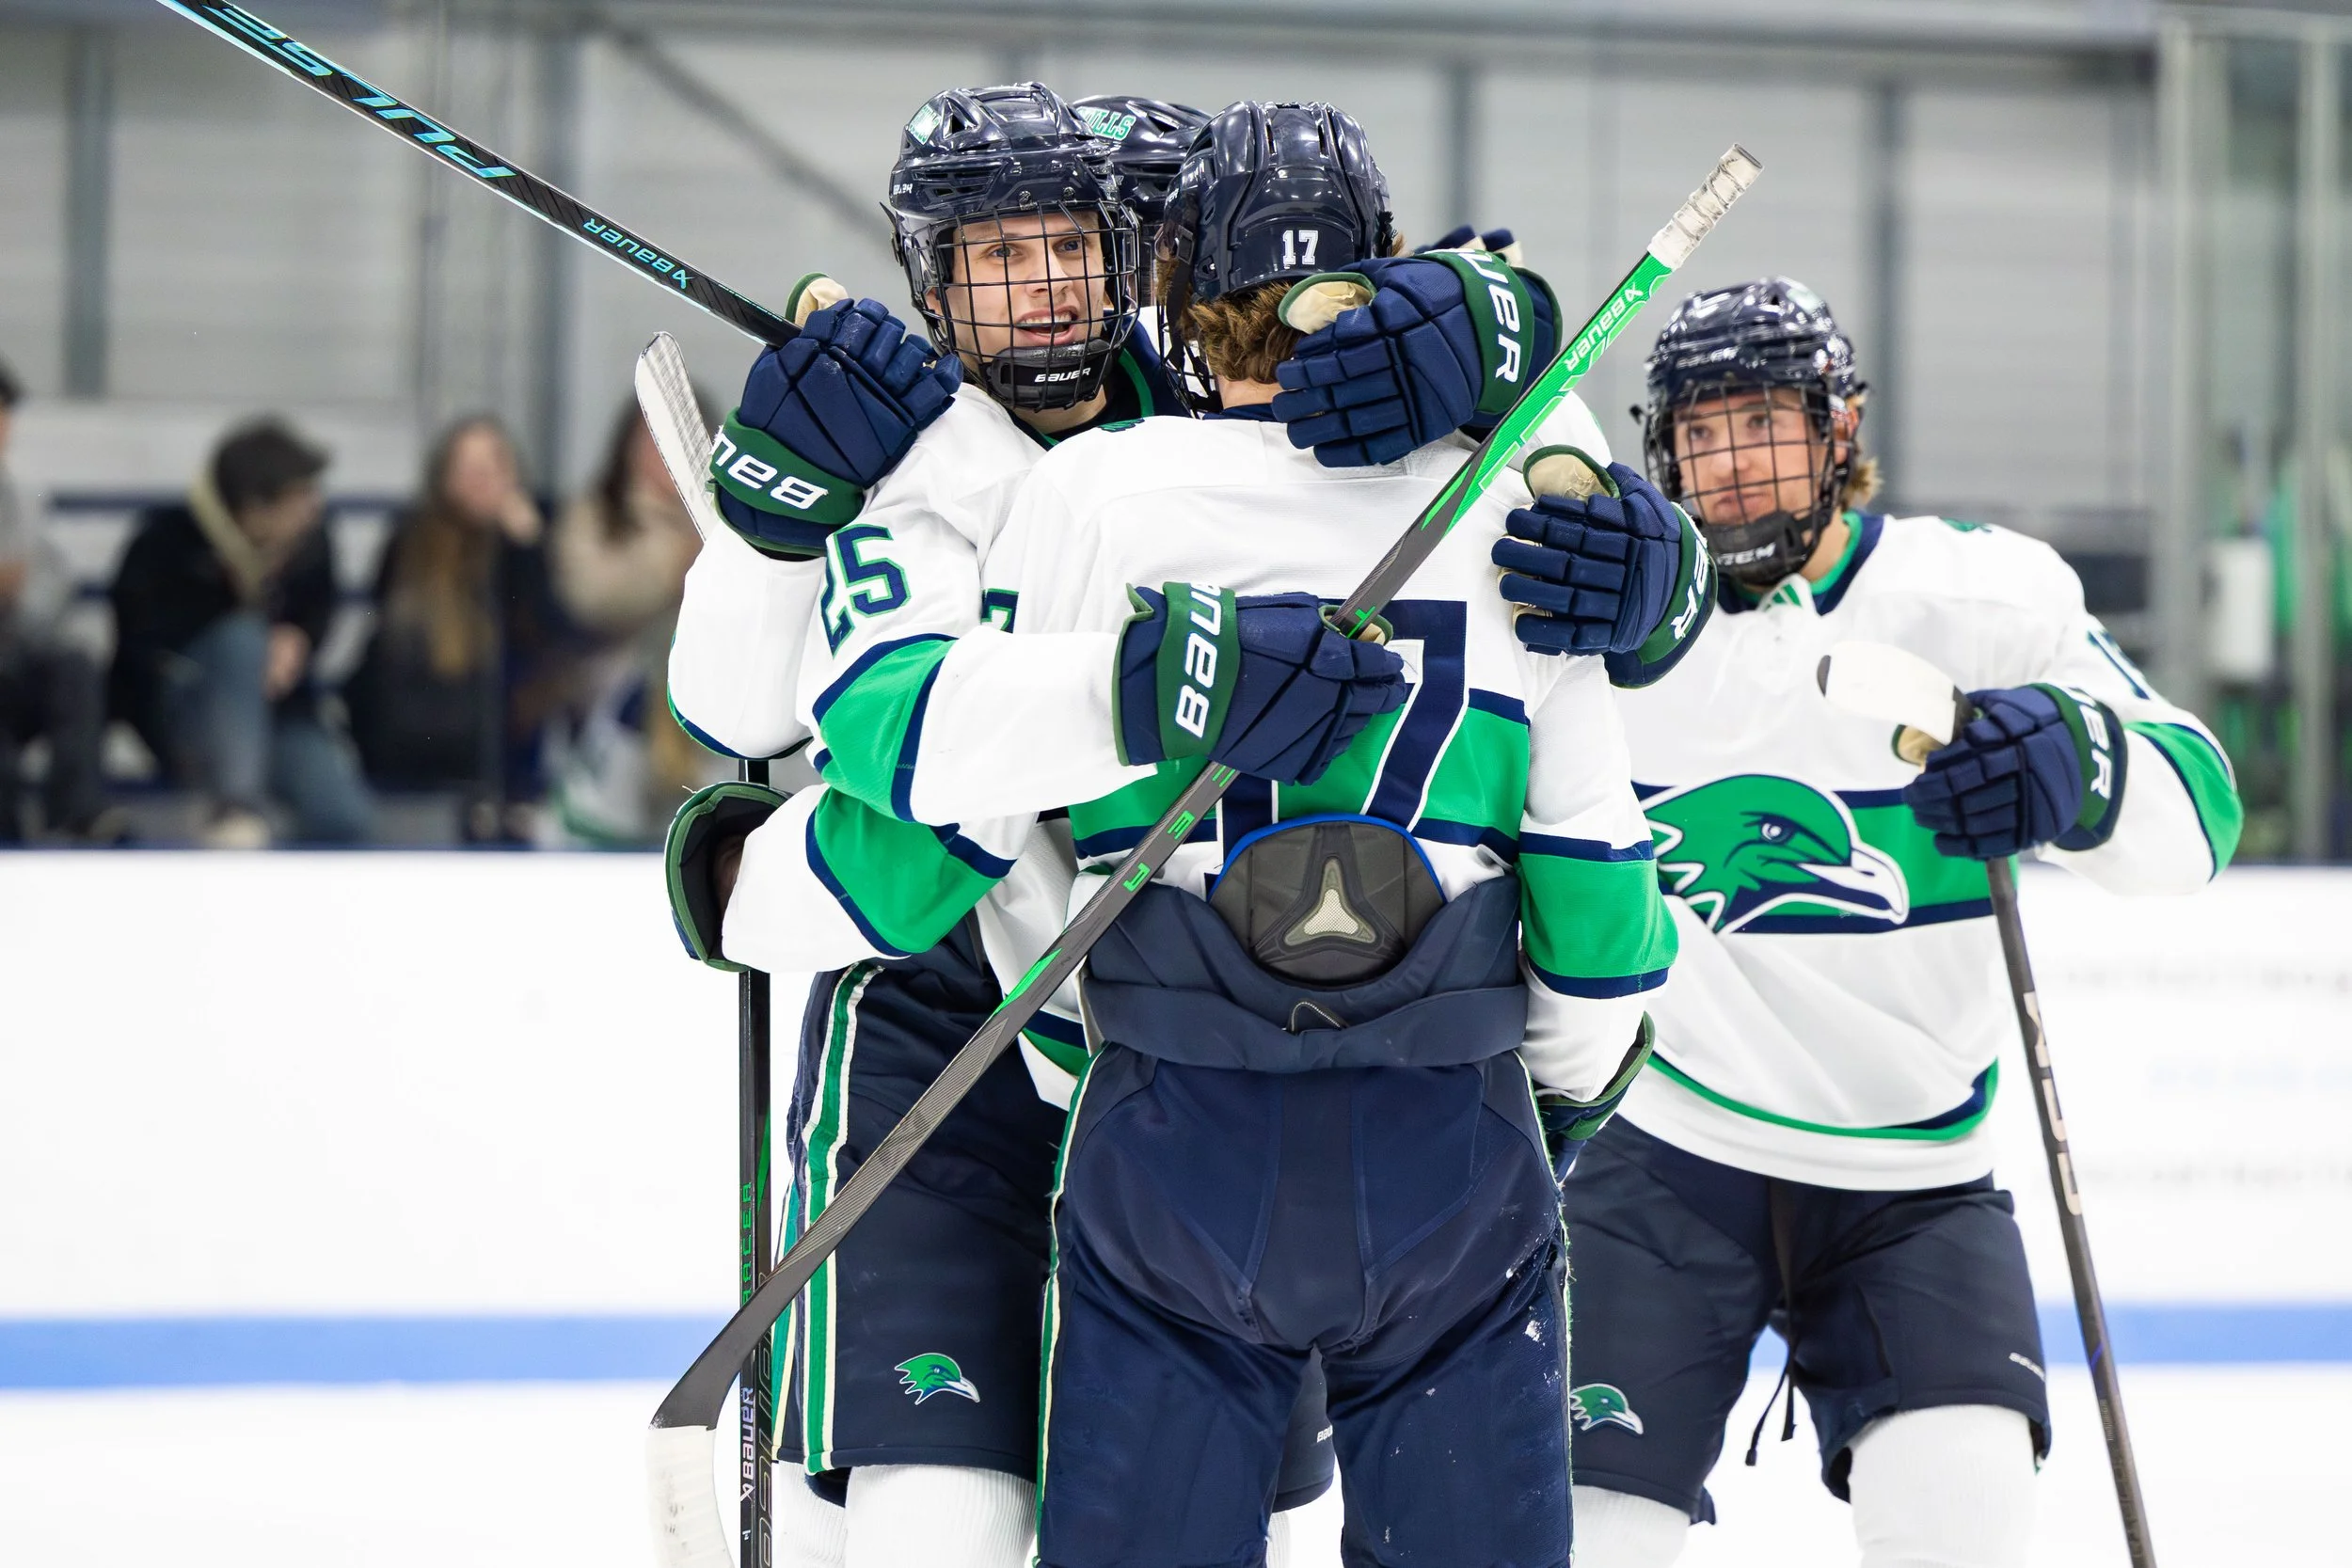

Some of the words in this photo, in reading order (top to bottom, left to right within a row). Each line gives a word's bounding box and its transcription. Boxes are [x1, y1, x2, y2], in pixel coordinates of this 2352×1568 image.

[582, 217, 675, 274] BAUER
[1282, 230, 1319, 265] 17
[1423, 247, 1522, 383] UER
[1564, 297, 1627, 372] BAUER
